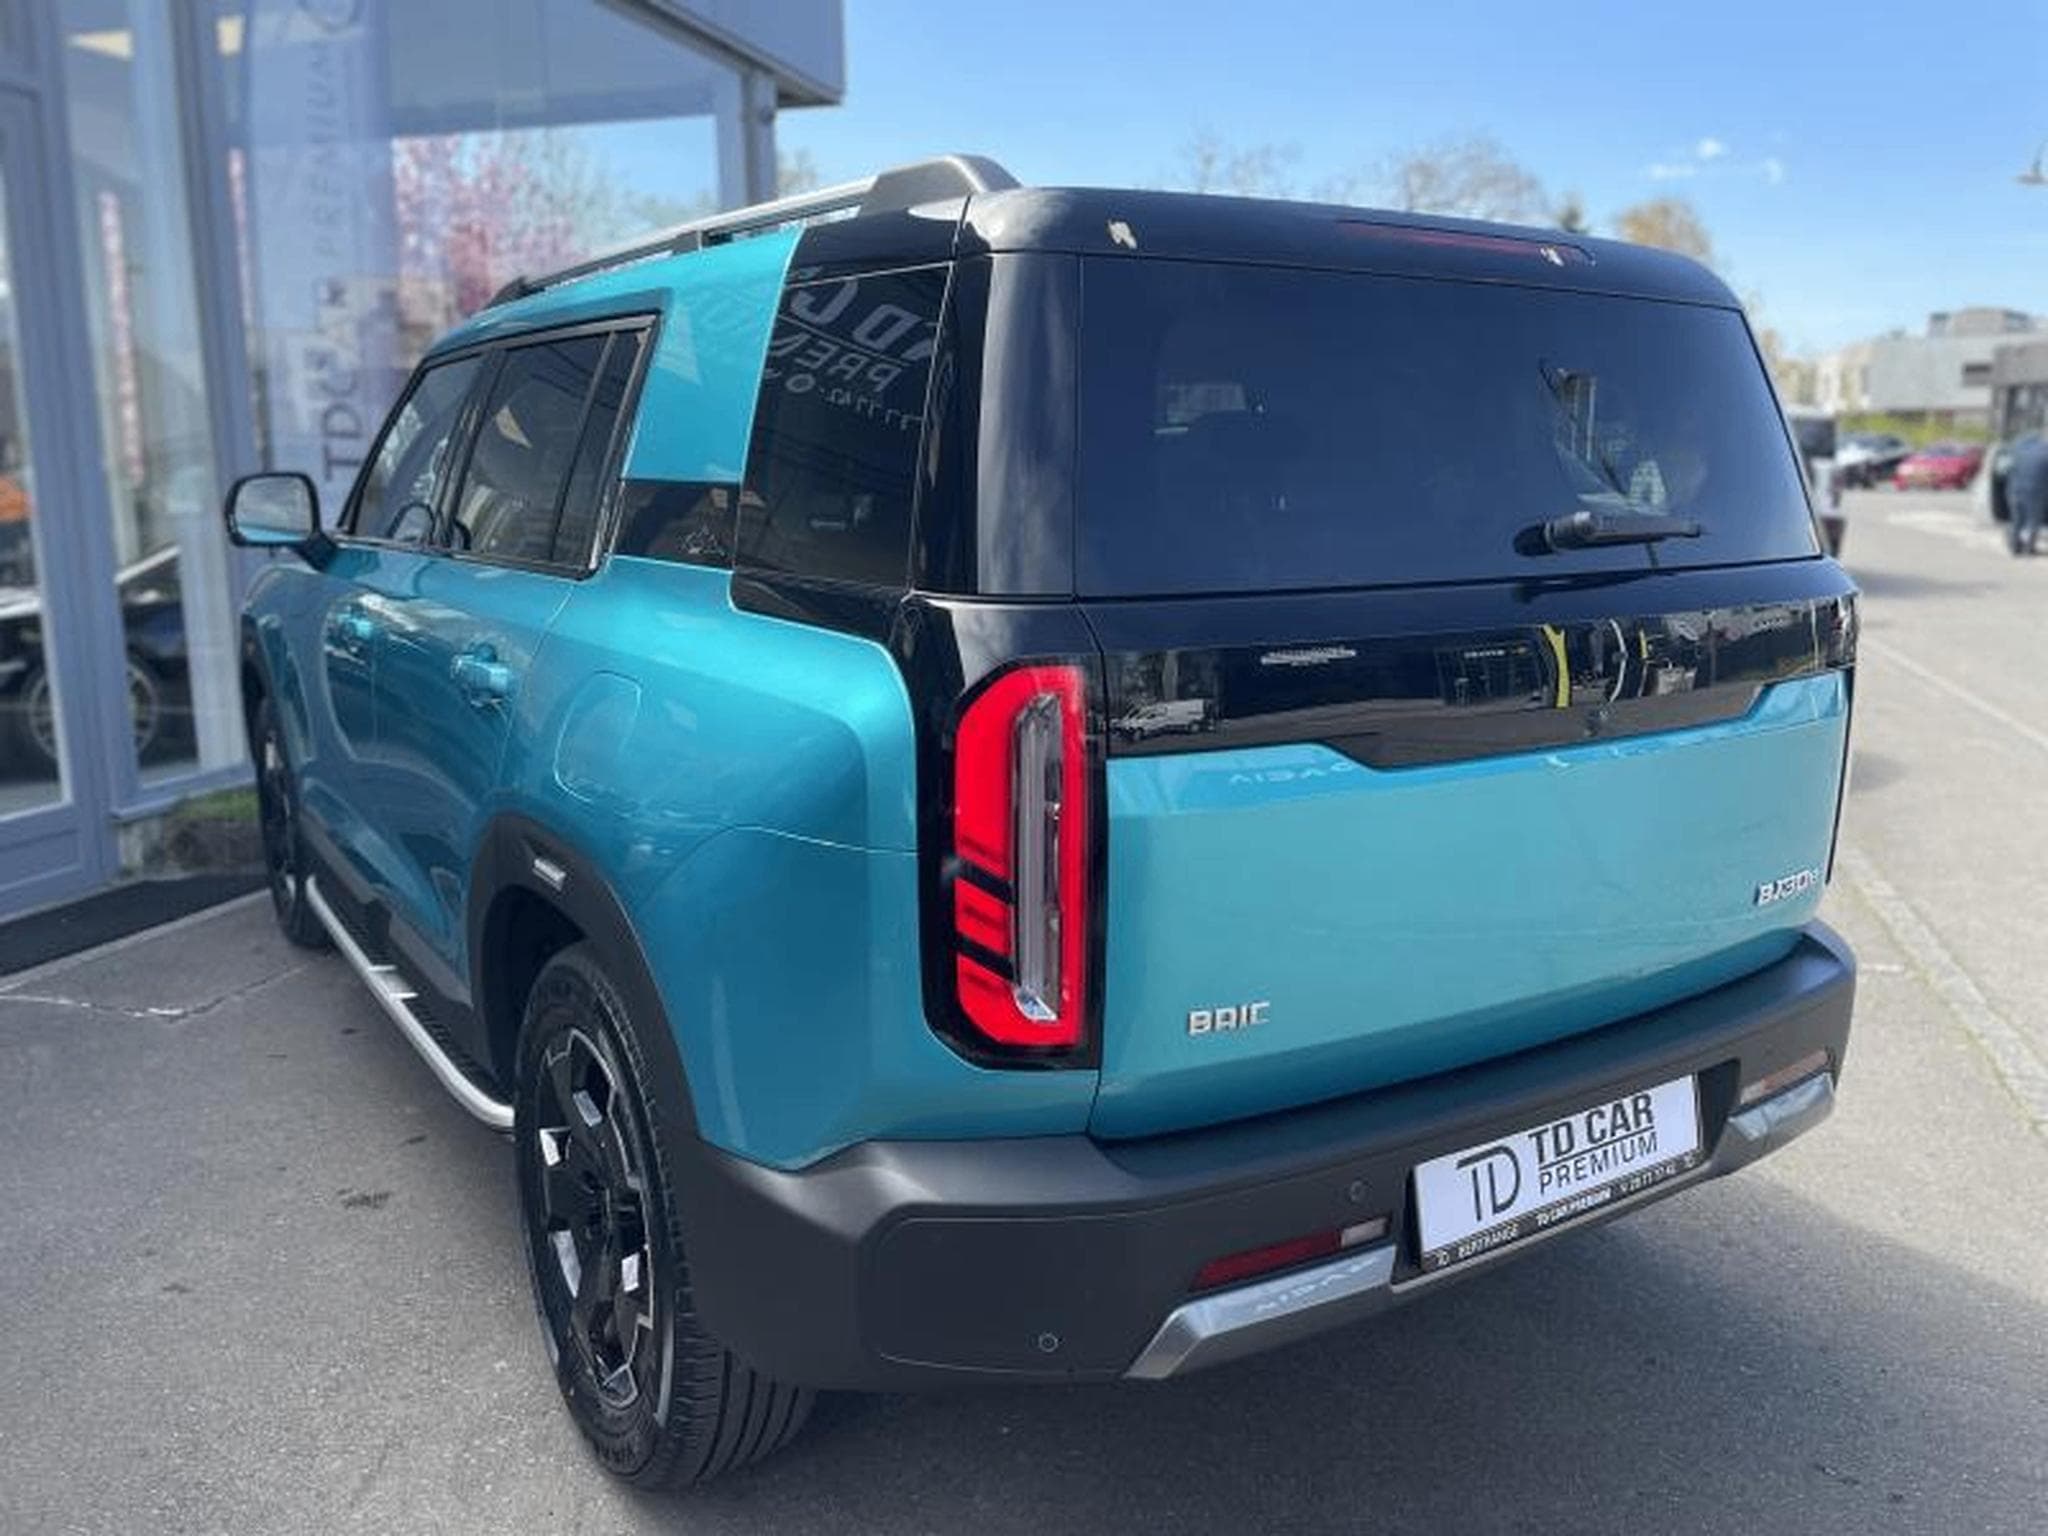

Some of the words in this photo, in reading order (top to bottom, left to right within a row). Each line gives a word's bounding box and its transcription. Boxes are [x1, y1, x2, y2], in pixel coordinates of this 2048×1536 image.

[1528, 1121, 1576, 1165] TD
[1585, 1093, 1655, 1145] CAR
[1539, 1131, 1659, 1196] PREMIUM
